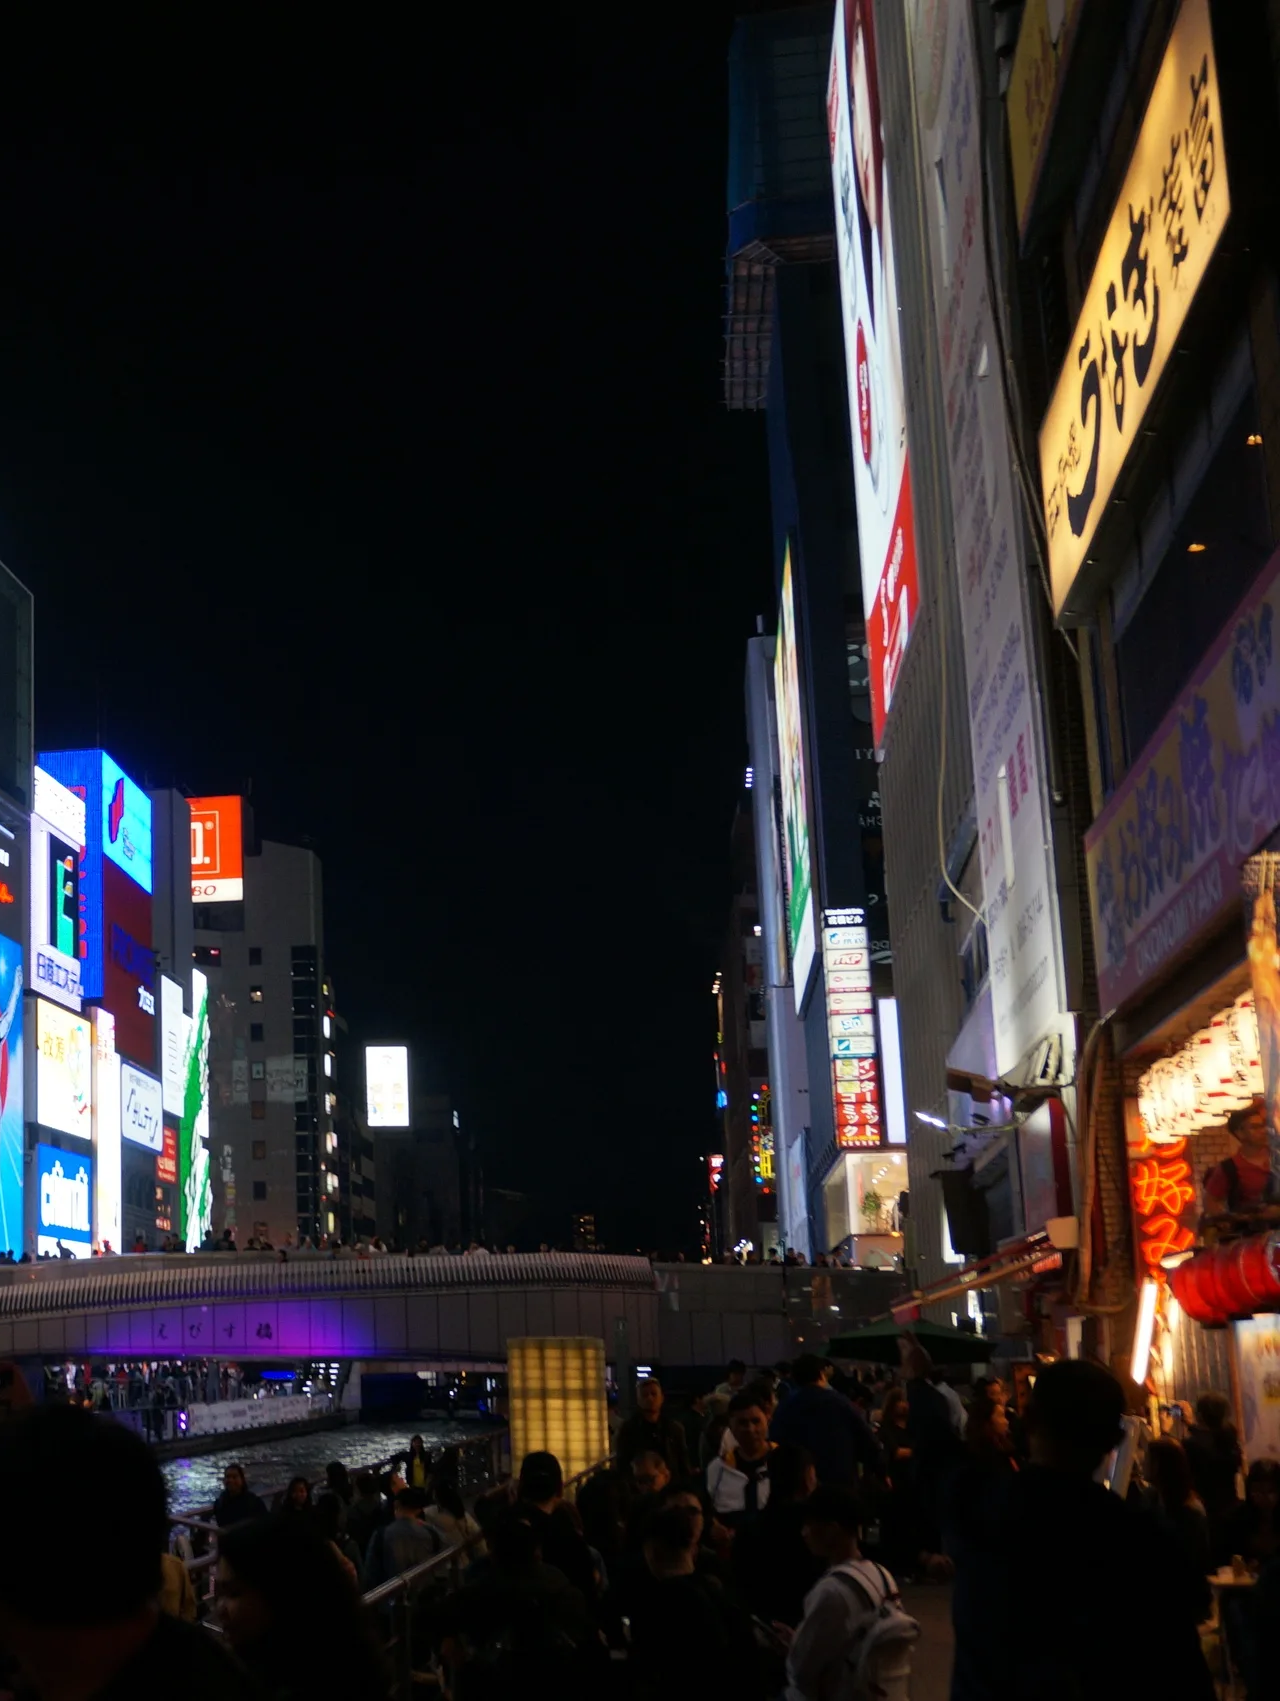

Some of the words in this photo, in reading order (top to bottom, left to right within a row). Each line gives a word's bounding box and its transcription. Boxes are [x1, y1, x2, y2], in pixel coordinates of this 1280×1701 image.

[840, 1092, 860, 1138] コミック
[858, 1057, 881, 1138] インターネット
